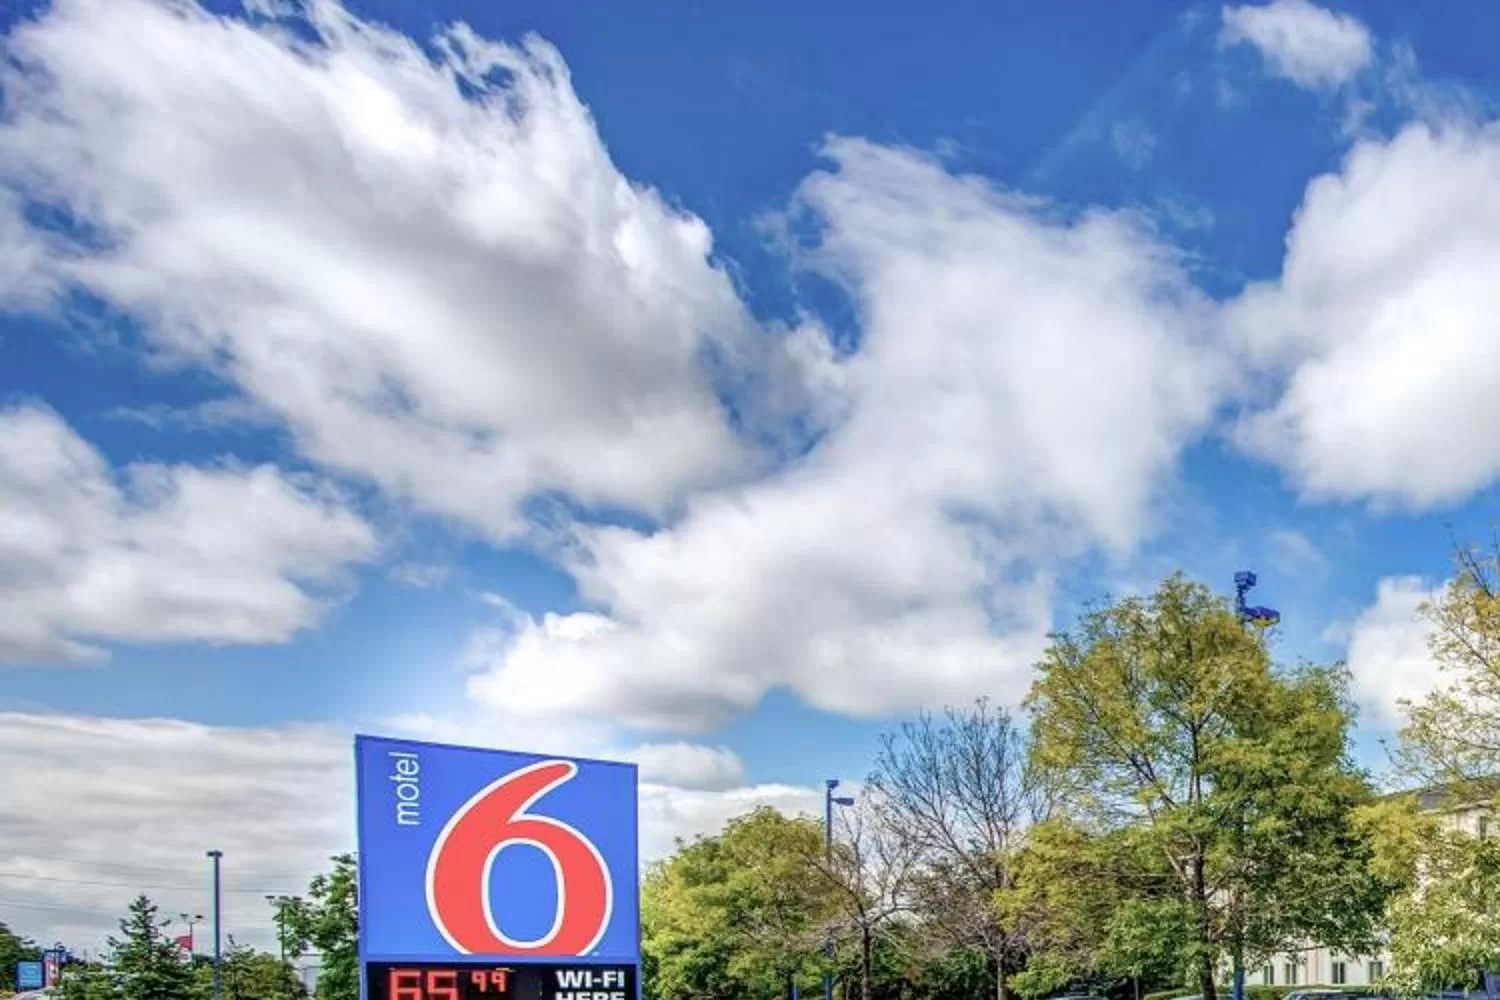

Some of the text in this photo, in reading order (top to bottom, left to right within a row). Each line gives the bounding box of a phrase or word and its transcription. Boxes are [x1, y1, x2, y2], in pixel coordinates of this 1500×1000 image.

[389, 752, 420, 826] motel
[425, 759, 613, 956] 6
[555, 970, 625, 988] WI-FI
